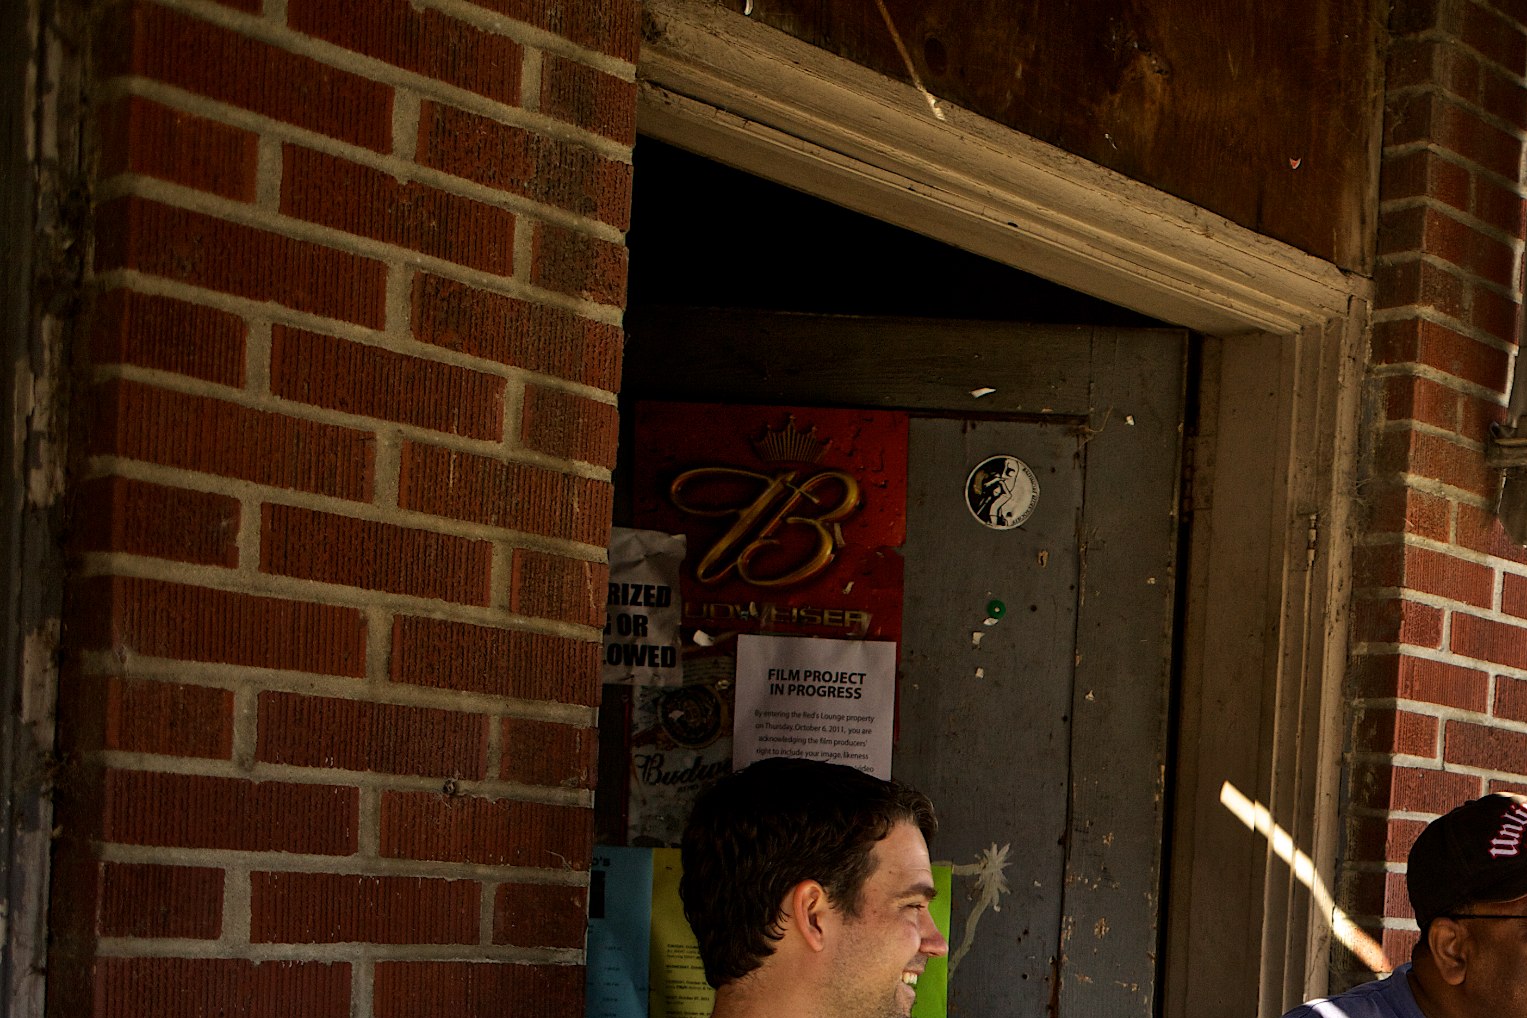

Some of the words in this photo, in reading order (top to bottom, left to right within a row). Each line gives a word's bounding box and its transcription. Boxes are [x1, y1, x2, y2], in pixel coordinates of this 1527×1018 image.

[617, 613, 648, 637] OR
[603, 643, 676, 668] OWED
[768, 669, 800, 681] FILM
[804, 670, 867, 685] PROJECT
[770, 683, 784, 695] IN
[788, 685, 862, 699] PROGRESS
[763, 711, 790, 719] entering
[803, 711, 819, 719] Red's
[821, 713, 845, 721] Lounge
[846, 715, 875, 724] property
[759, 735, 806, 745] acknowledging
[757, 748, 771, 756] right
[843, 752, 868, 760] likeness
